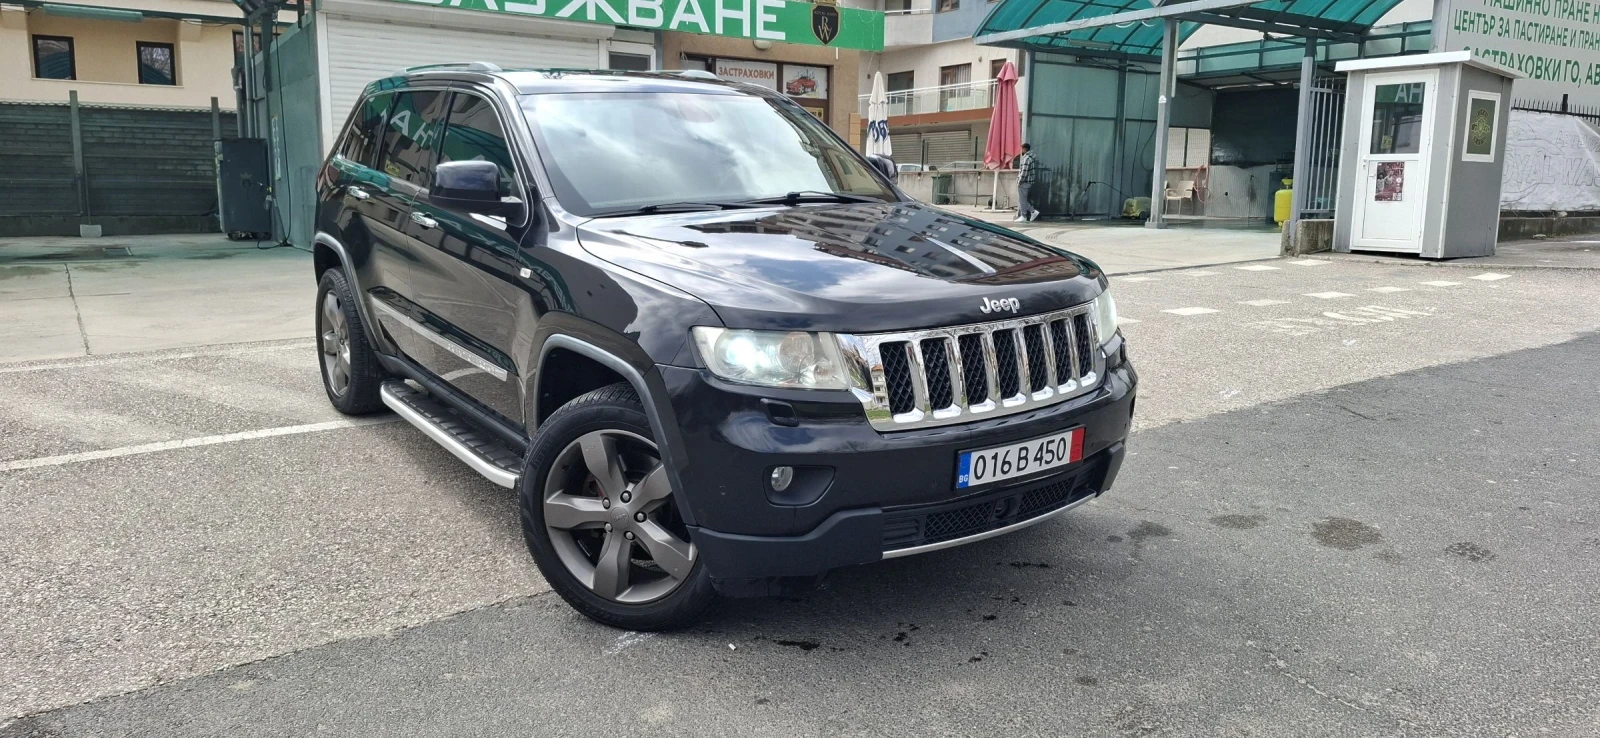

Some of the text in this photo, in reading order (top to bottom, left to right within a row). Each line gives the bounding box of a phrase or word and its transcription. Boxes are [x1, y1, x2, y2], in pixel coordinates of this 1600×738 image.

[1553, 0, 1591, 23] ПРАНЕ
[1454, 9, 1496, 35] ЦЕНТЪР
[1497, 16, 1510, 38] ЗА
[1512, 19, 1569, 47] ПАСТИРАНЕ
[1569, 29, 1577, 47] И
[718, 66, 775, 80] ЗАСТРАХОВКИ
[980, 296, 1020, 314] Jeep
[974, 437, 1067, 481] 016 B 450
[958, 474, 969, 484] BG
